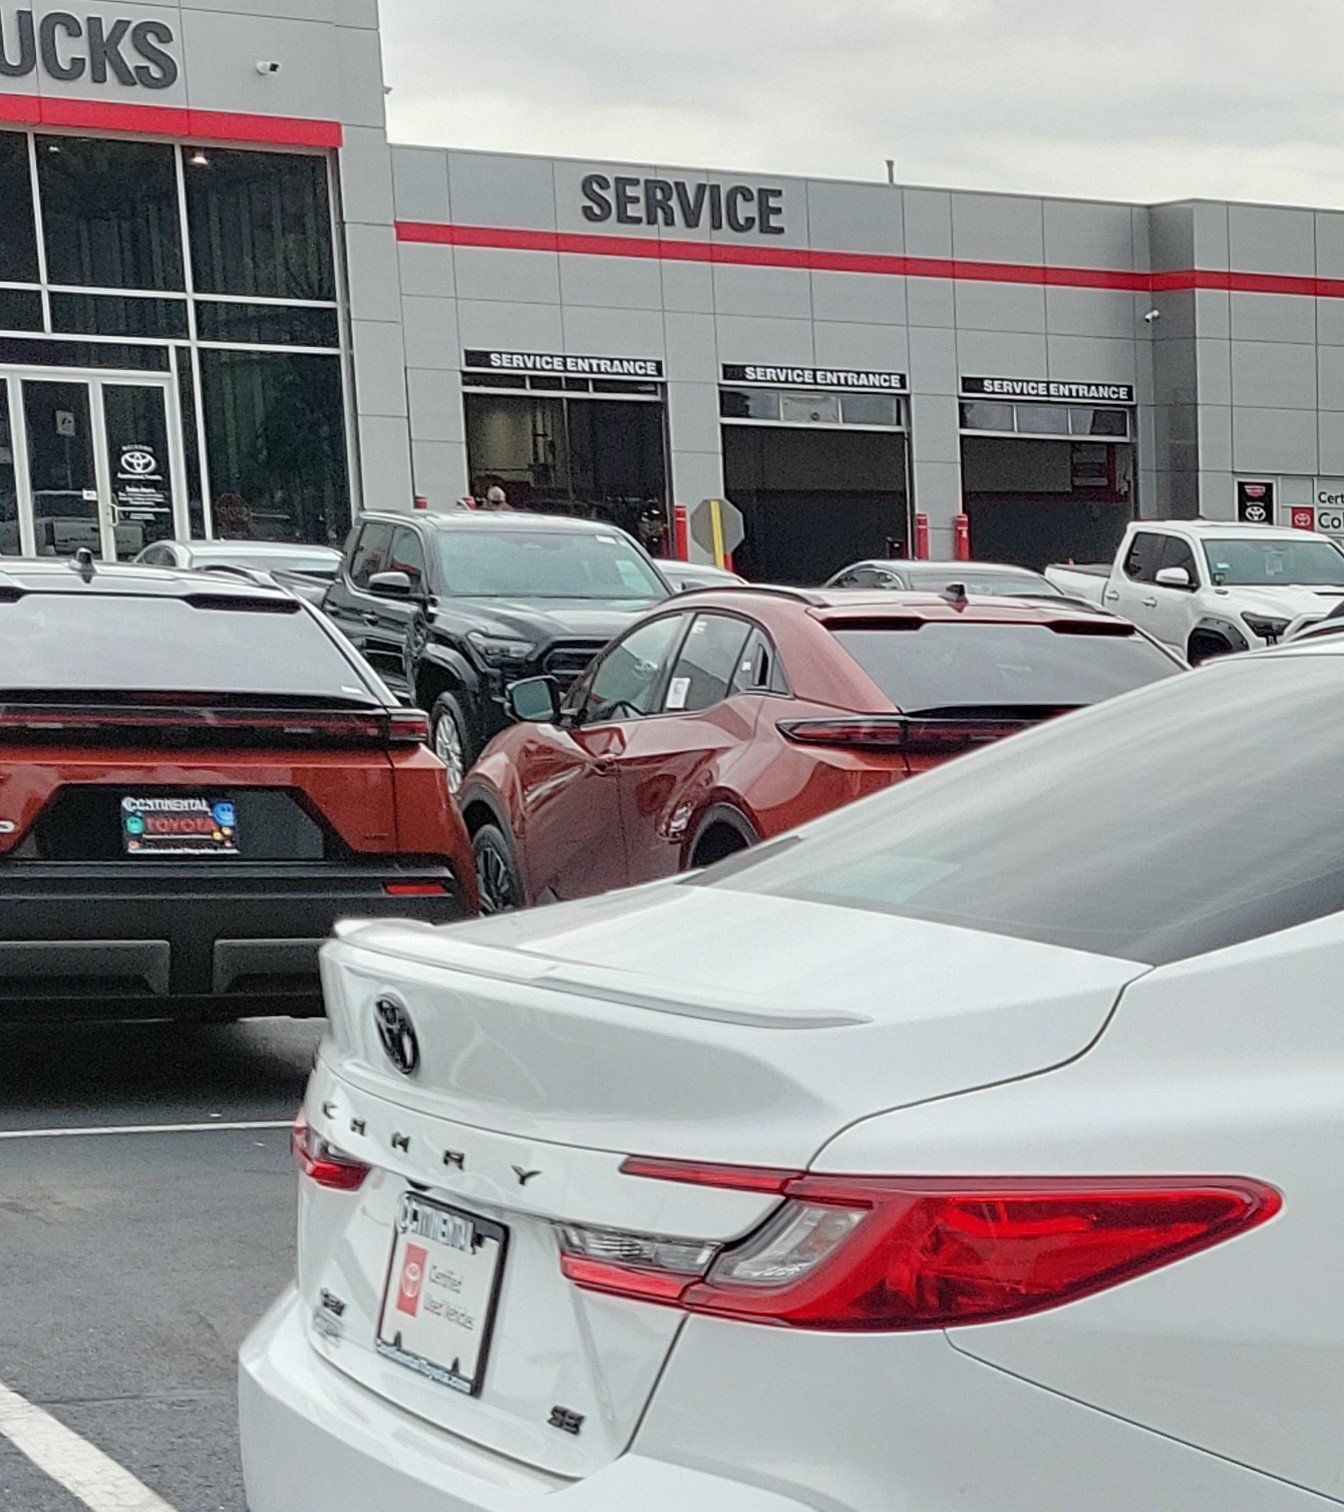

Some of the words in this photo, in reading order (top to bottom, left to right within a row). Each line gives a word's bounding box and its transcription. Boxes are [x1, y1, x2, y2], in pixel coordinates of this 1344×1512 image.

[581, 174, 786, 235] SERVICE
[490, 353, 564, 371] SERVICE
[567, 358, 657, 375] ENTRANCE
[744, 366, 814, 384] SERVICE
[816, 370, 900, 387] ENTRANCE
[983, 378, 1048, 395] SERVICE
[1049, 382, 1129, 399] ENTRANCE
